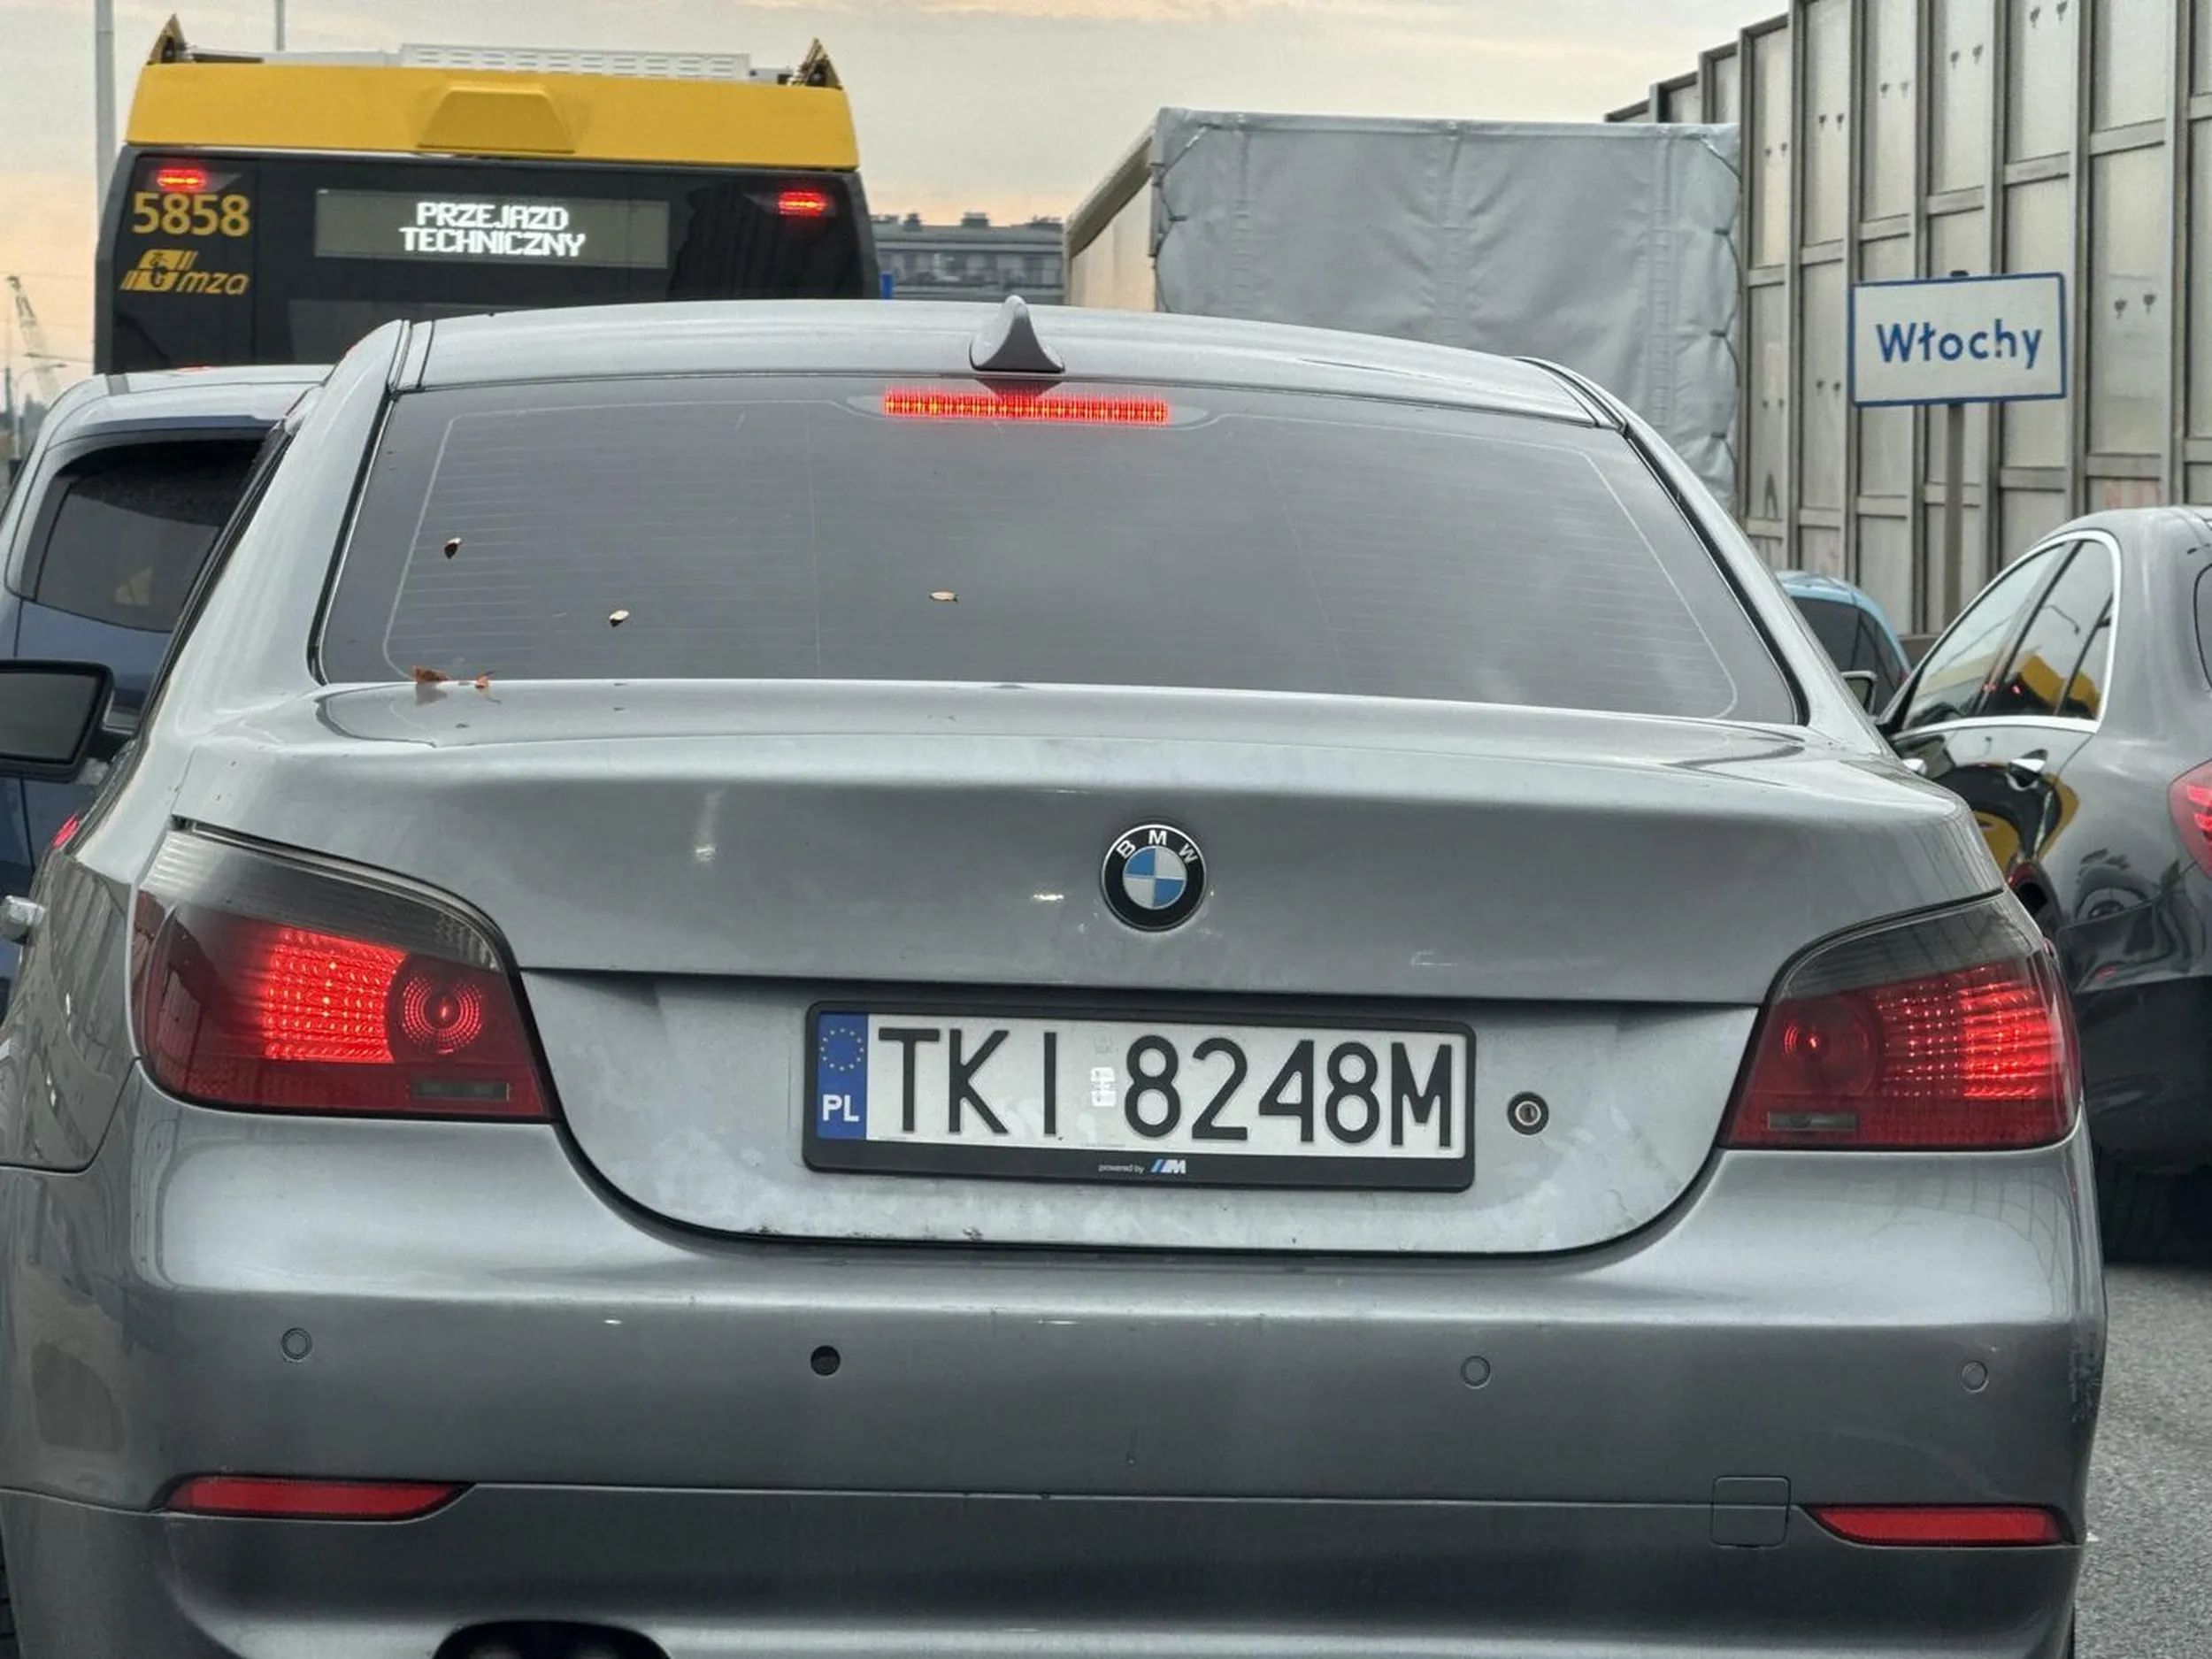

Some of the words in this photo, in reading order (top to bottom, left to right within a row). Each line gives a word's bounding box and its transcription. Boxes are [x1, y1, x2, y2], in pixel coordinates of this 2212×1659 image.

[132, 191, 250, 236] 5858
[416, 202, 569, 230] PRZEJAZD
[399, 227, 586, 257] TECHNICZNY
[176, 271, 249, 296] mza
[1875, 319, 2042, 370] Włochy
[1116, 829, 1198, 864] BMW
[879, 1027, 1058, 1136] TKI
[1125, 1034, 1452, 1148] 8248M
[822, 1094, 860, 1122] PL
[1098, 1164, 1133, 1172] powered
[1134, 1164, 1145, 1175] by
